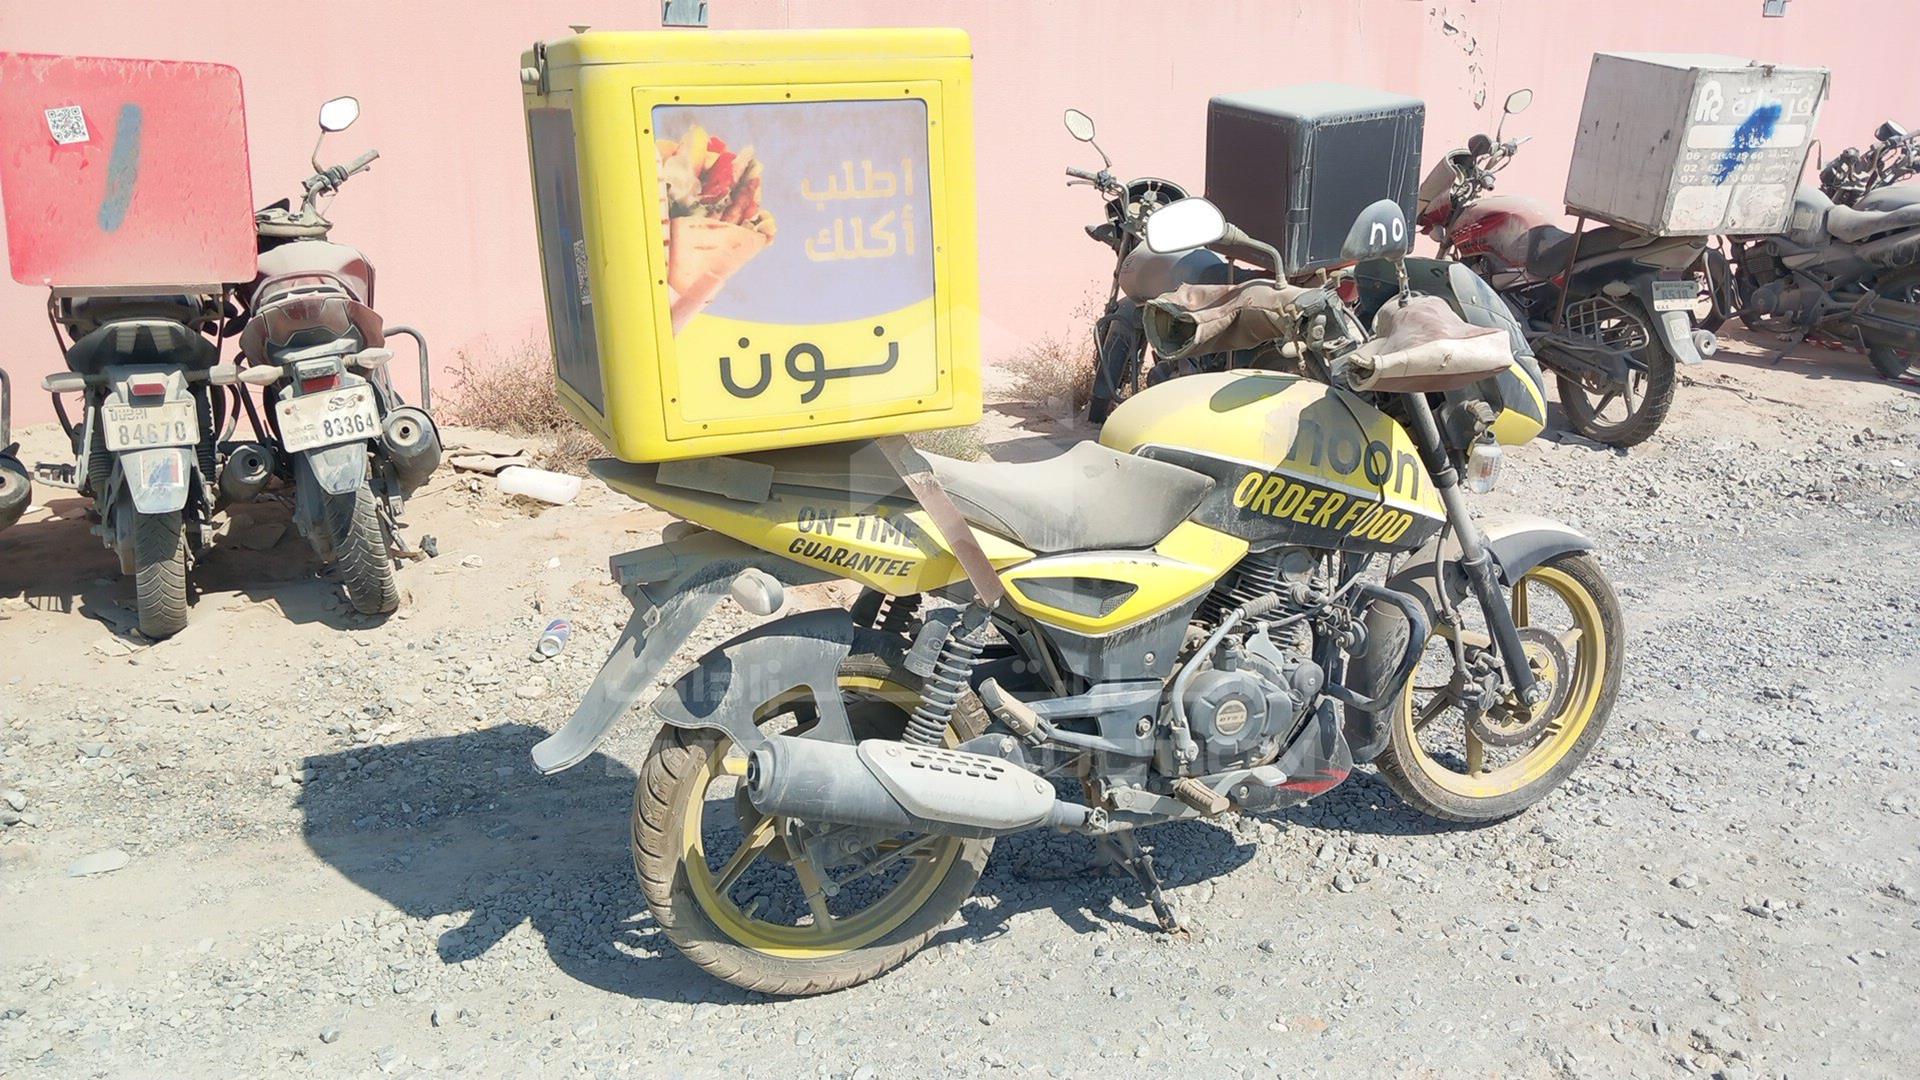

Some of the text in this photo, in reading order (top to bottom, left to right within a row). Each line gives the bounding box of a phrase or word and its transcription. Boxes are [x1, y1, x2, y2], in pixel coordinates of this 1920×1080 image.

[719, 325, 899, 404] نون
[118, 421, 187, 446] 84670
[323, 412, 375, 438] 83364
[1286, 419, 1420, 501] noon
[797, 505, 920, 550] ON-TIME
[1232, 471, 1414, 544] ORDER FOOD
[788, 537, 916, 577] GUARANTEE
